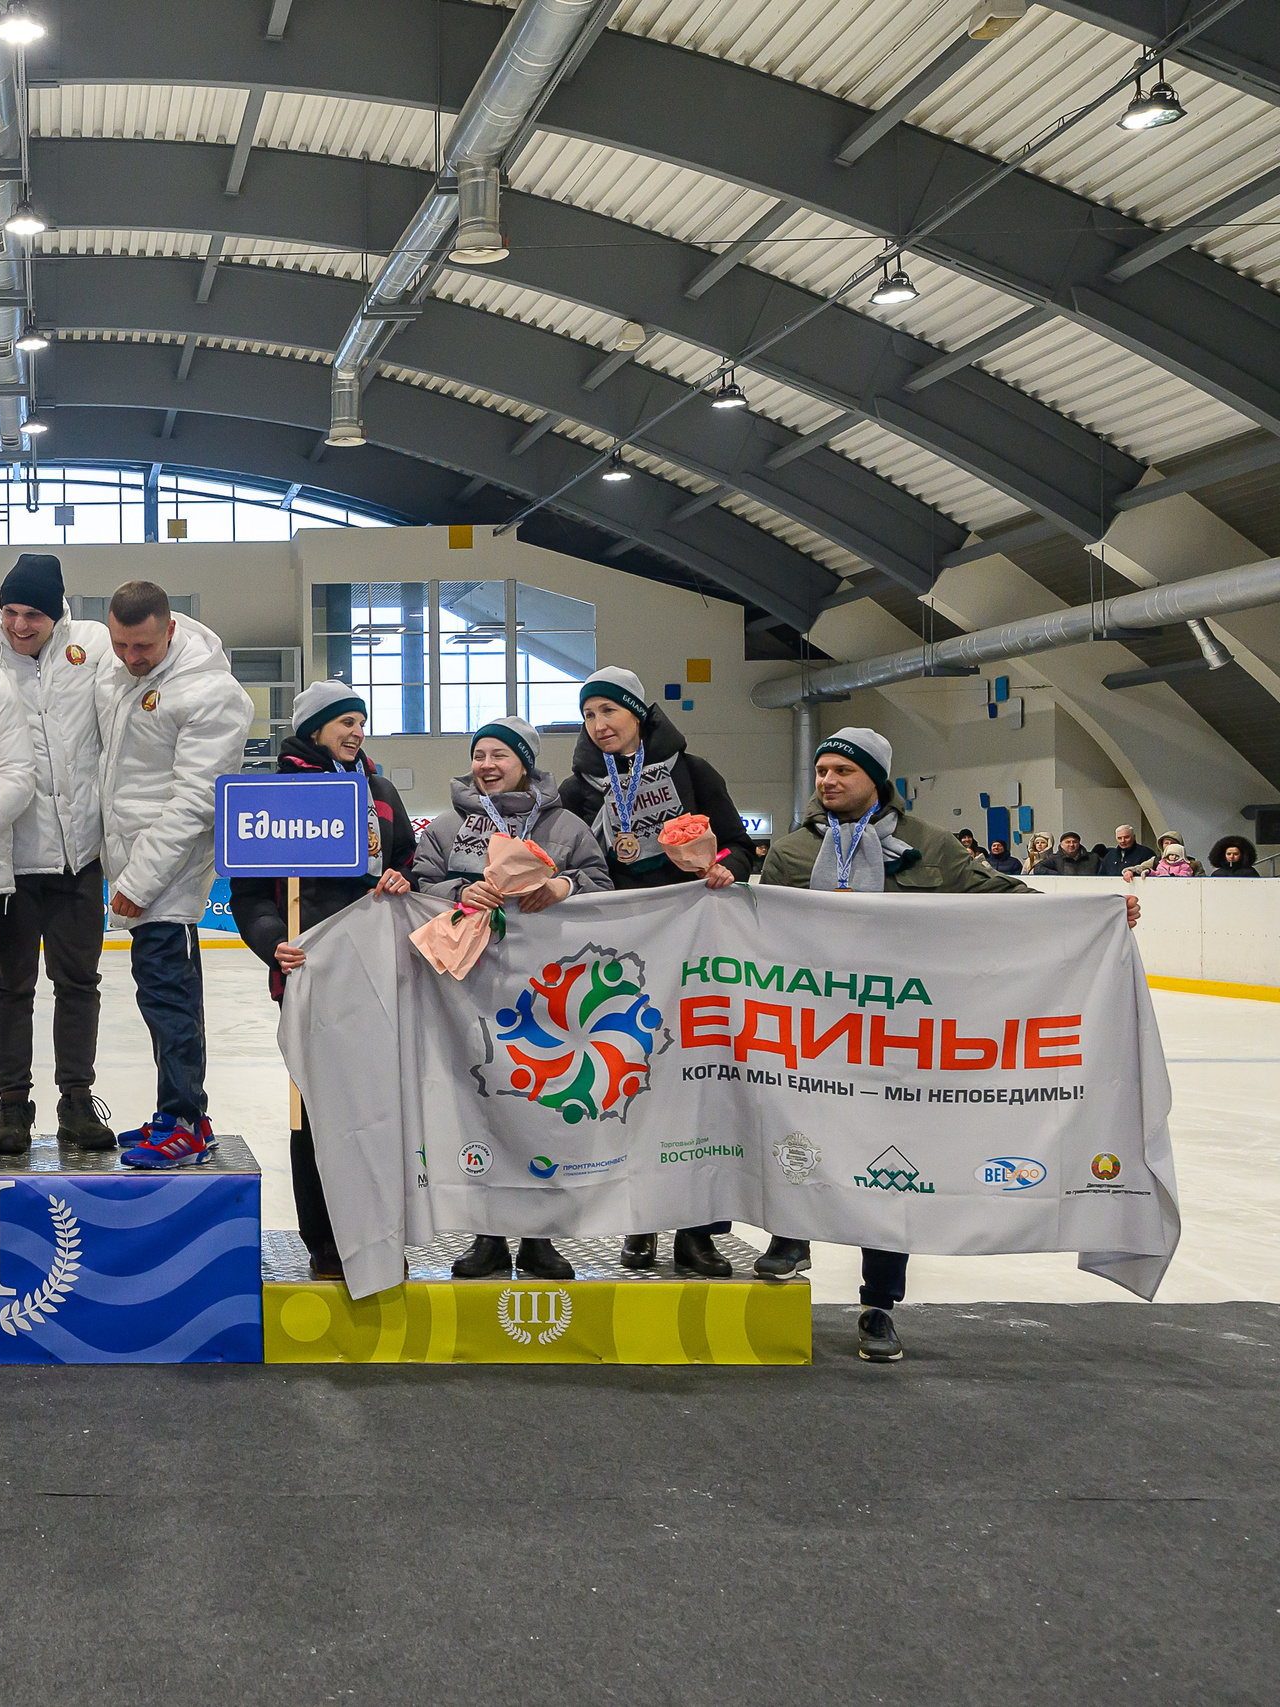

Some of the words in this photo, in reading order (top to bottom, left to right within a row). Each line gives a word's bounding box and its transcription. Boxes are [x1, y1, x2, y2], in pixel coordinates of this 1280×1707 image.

[622, 694, 647, 717] БЕЛАРУ
[821, 741, 855, 755] ЛАРУСЬ
[611, 786, 673, 817] ЕИНЫЕ
[238, 810, 345, 840] Единые
[681, 956, 933, 1010] КОМАНДА
[680, 995, 1082, 1070] ЕДИНЫЕ
[682, 1064, 741, 1081] КОГДА
[746, 1069, 782, 1086] МЫ
[788, 1075, 854, 1097] ЕДИНЫ
[884, 1086, 921, 1102] МЫ
[928, 1085, 1084, 1105] НЕПОБЕДИМЫ!
[563, 1154, 628, 1170] ПРОМТРАНСИНВЕСТ
[660, 1144, 744, 1163] ВОСТОЧНЫЙ
[512, 1291, 558, 1324] III
